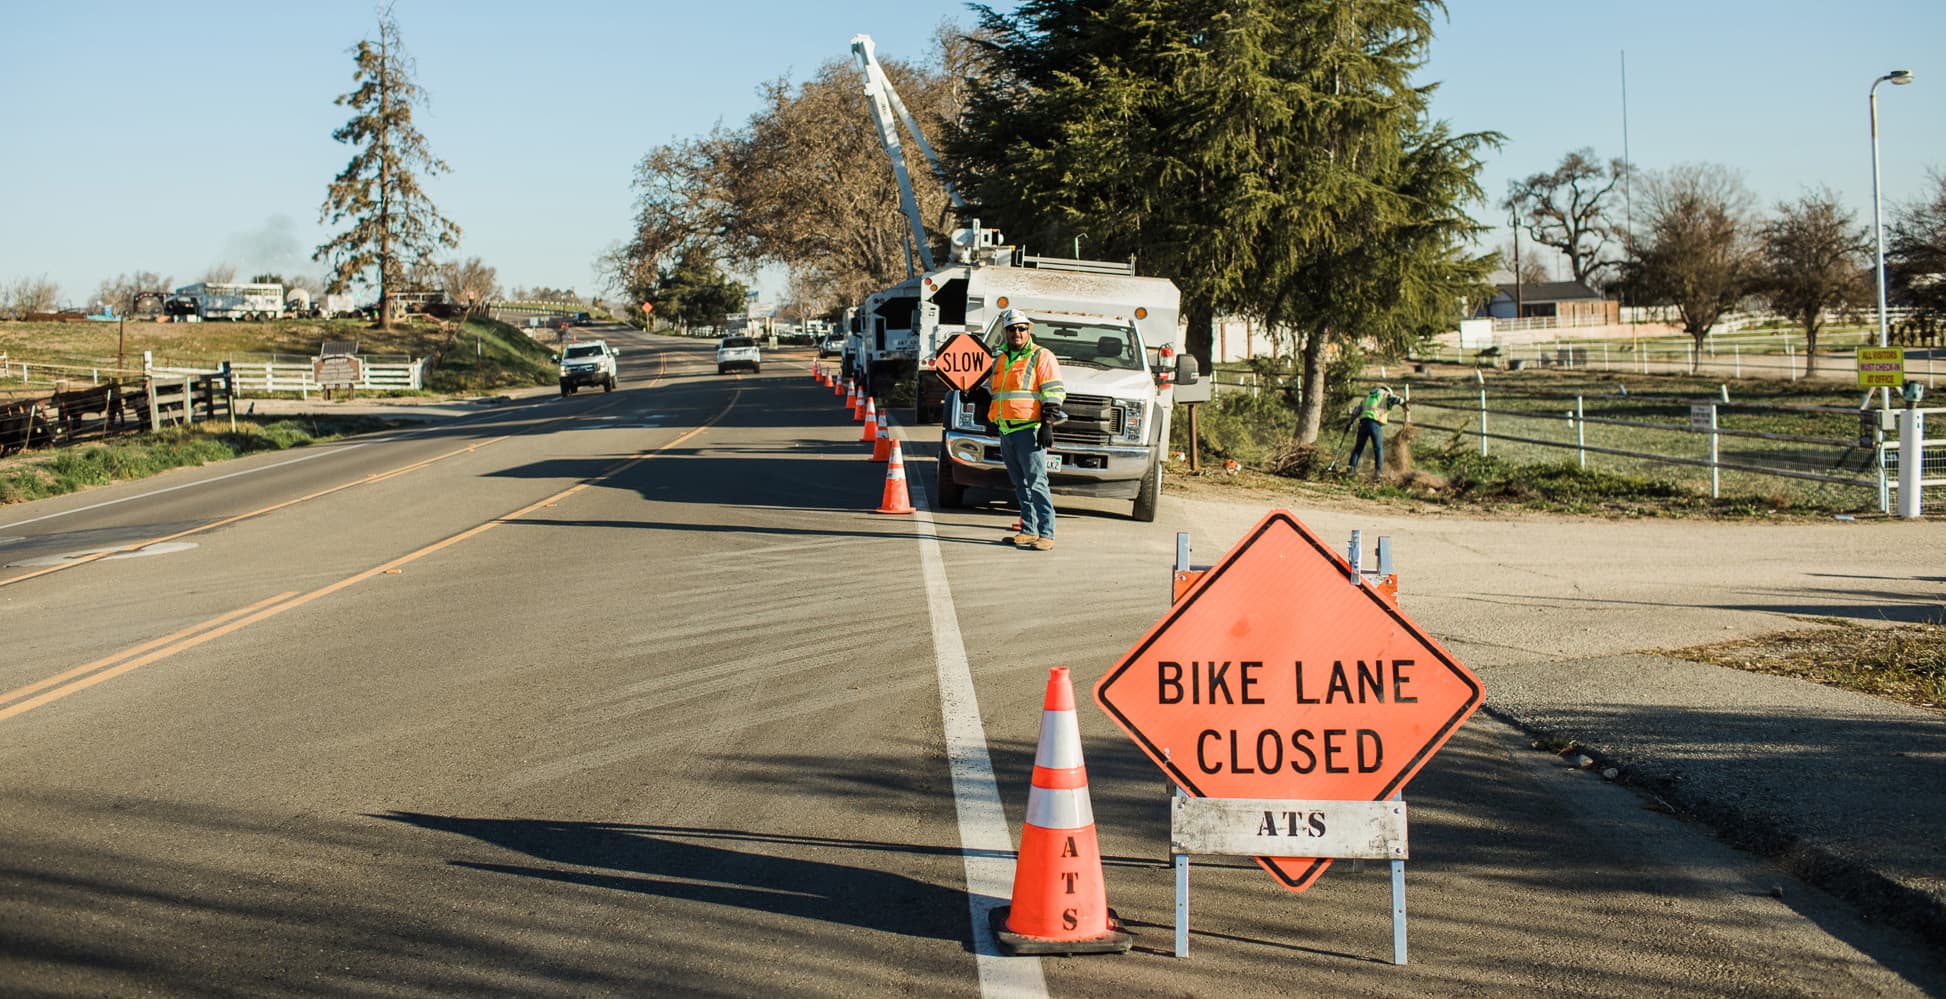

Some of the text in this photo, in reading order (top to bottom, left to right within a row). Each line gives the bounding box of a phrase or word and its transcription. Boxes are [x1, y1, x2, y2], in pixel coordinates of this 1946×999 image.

[943, 352, 984, 372] SLOW
[1863, 352, 1872, 360] ALL
[1158, 660, 1418, 705] BIKE LANE
[1197, 729, 1383, 775] CLOSED
[1257, 810, 1327, 838] ATS
